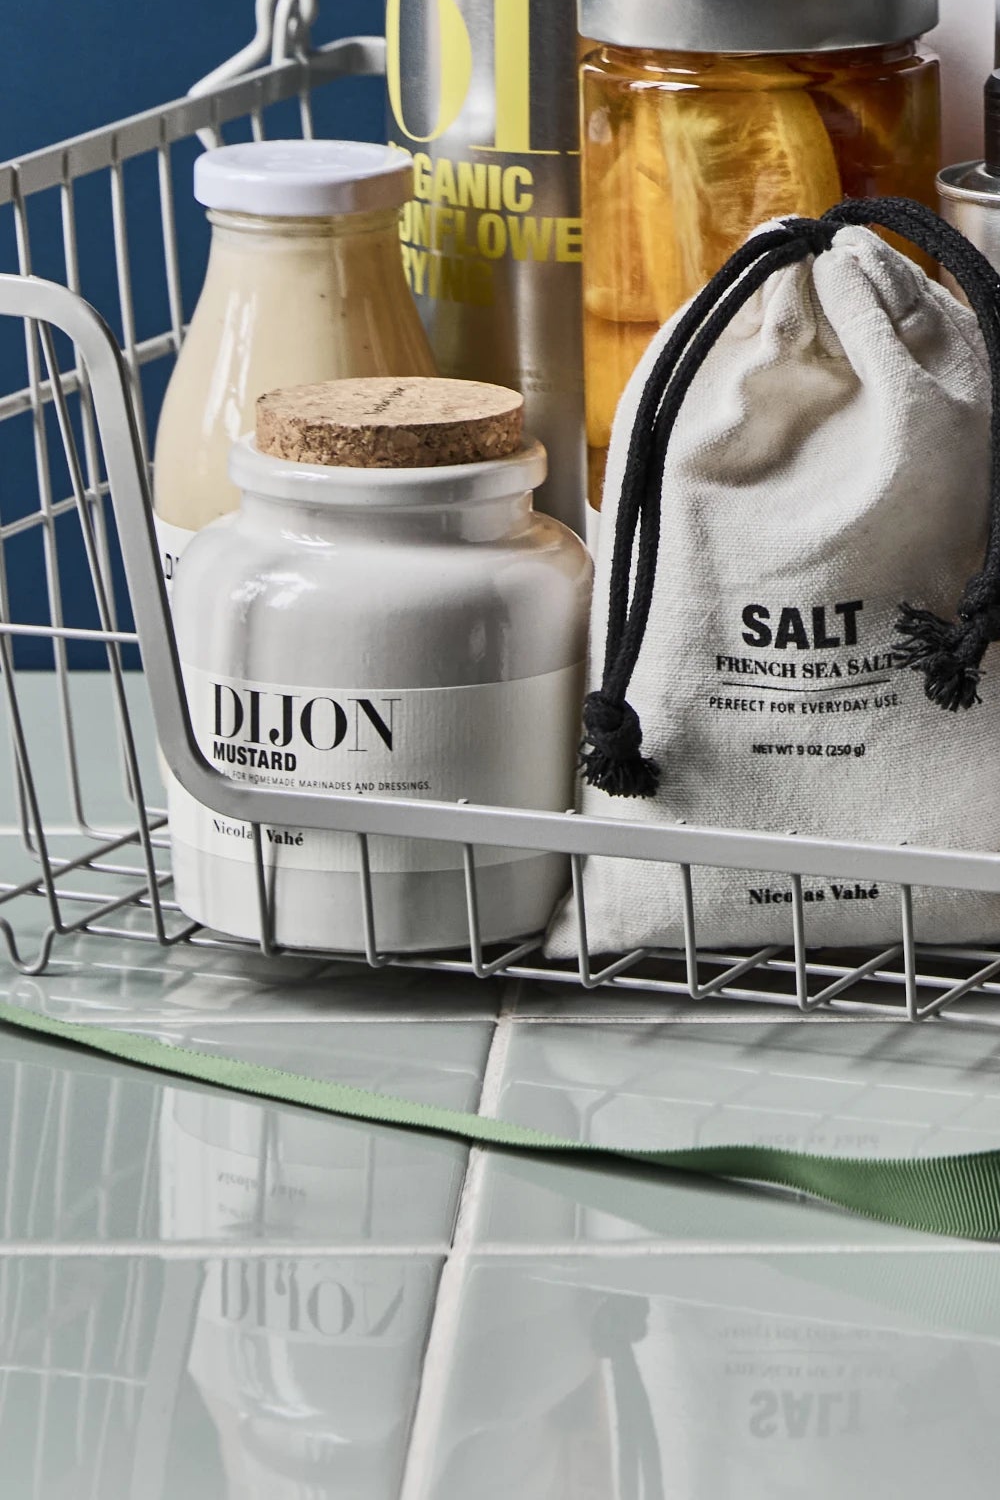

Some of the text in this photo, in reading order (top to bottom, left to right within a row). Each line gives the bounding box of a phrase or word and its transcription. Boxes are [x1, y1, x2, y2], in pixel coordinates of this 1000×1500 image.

[389, 141, 533, 213] GANIC
[399, 200, 583, 263] UNFLOWE
[742, 601, 863, 650] SALT
[716, 652, 896, 679] FRENCH SEA SALT
[209, 681, 402, 752] DIJON
[710, 694, 903, 714] PERFECT FOR EVERYDAY USE.
[213, 740, 297, 772] MUSTARD
[752, 743, 866, 757] NET WT 9 OZ (250 g)
[249, 773, 295, 787] HOMEMADE
[299, 779, 351, 791] MARINADES
[355, 782, 375, 791] AND
[378, 780, 432, 791] DRESSINGS.
[213, 818, 304, 846] Nicola Vahé
[749, 884, 879, 904] Nicoas Vahé
